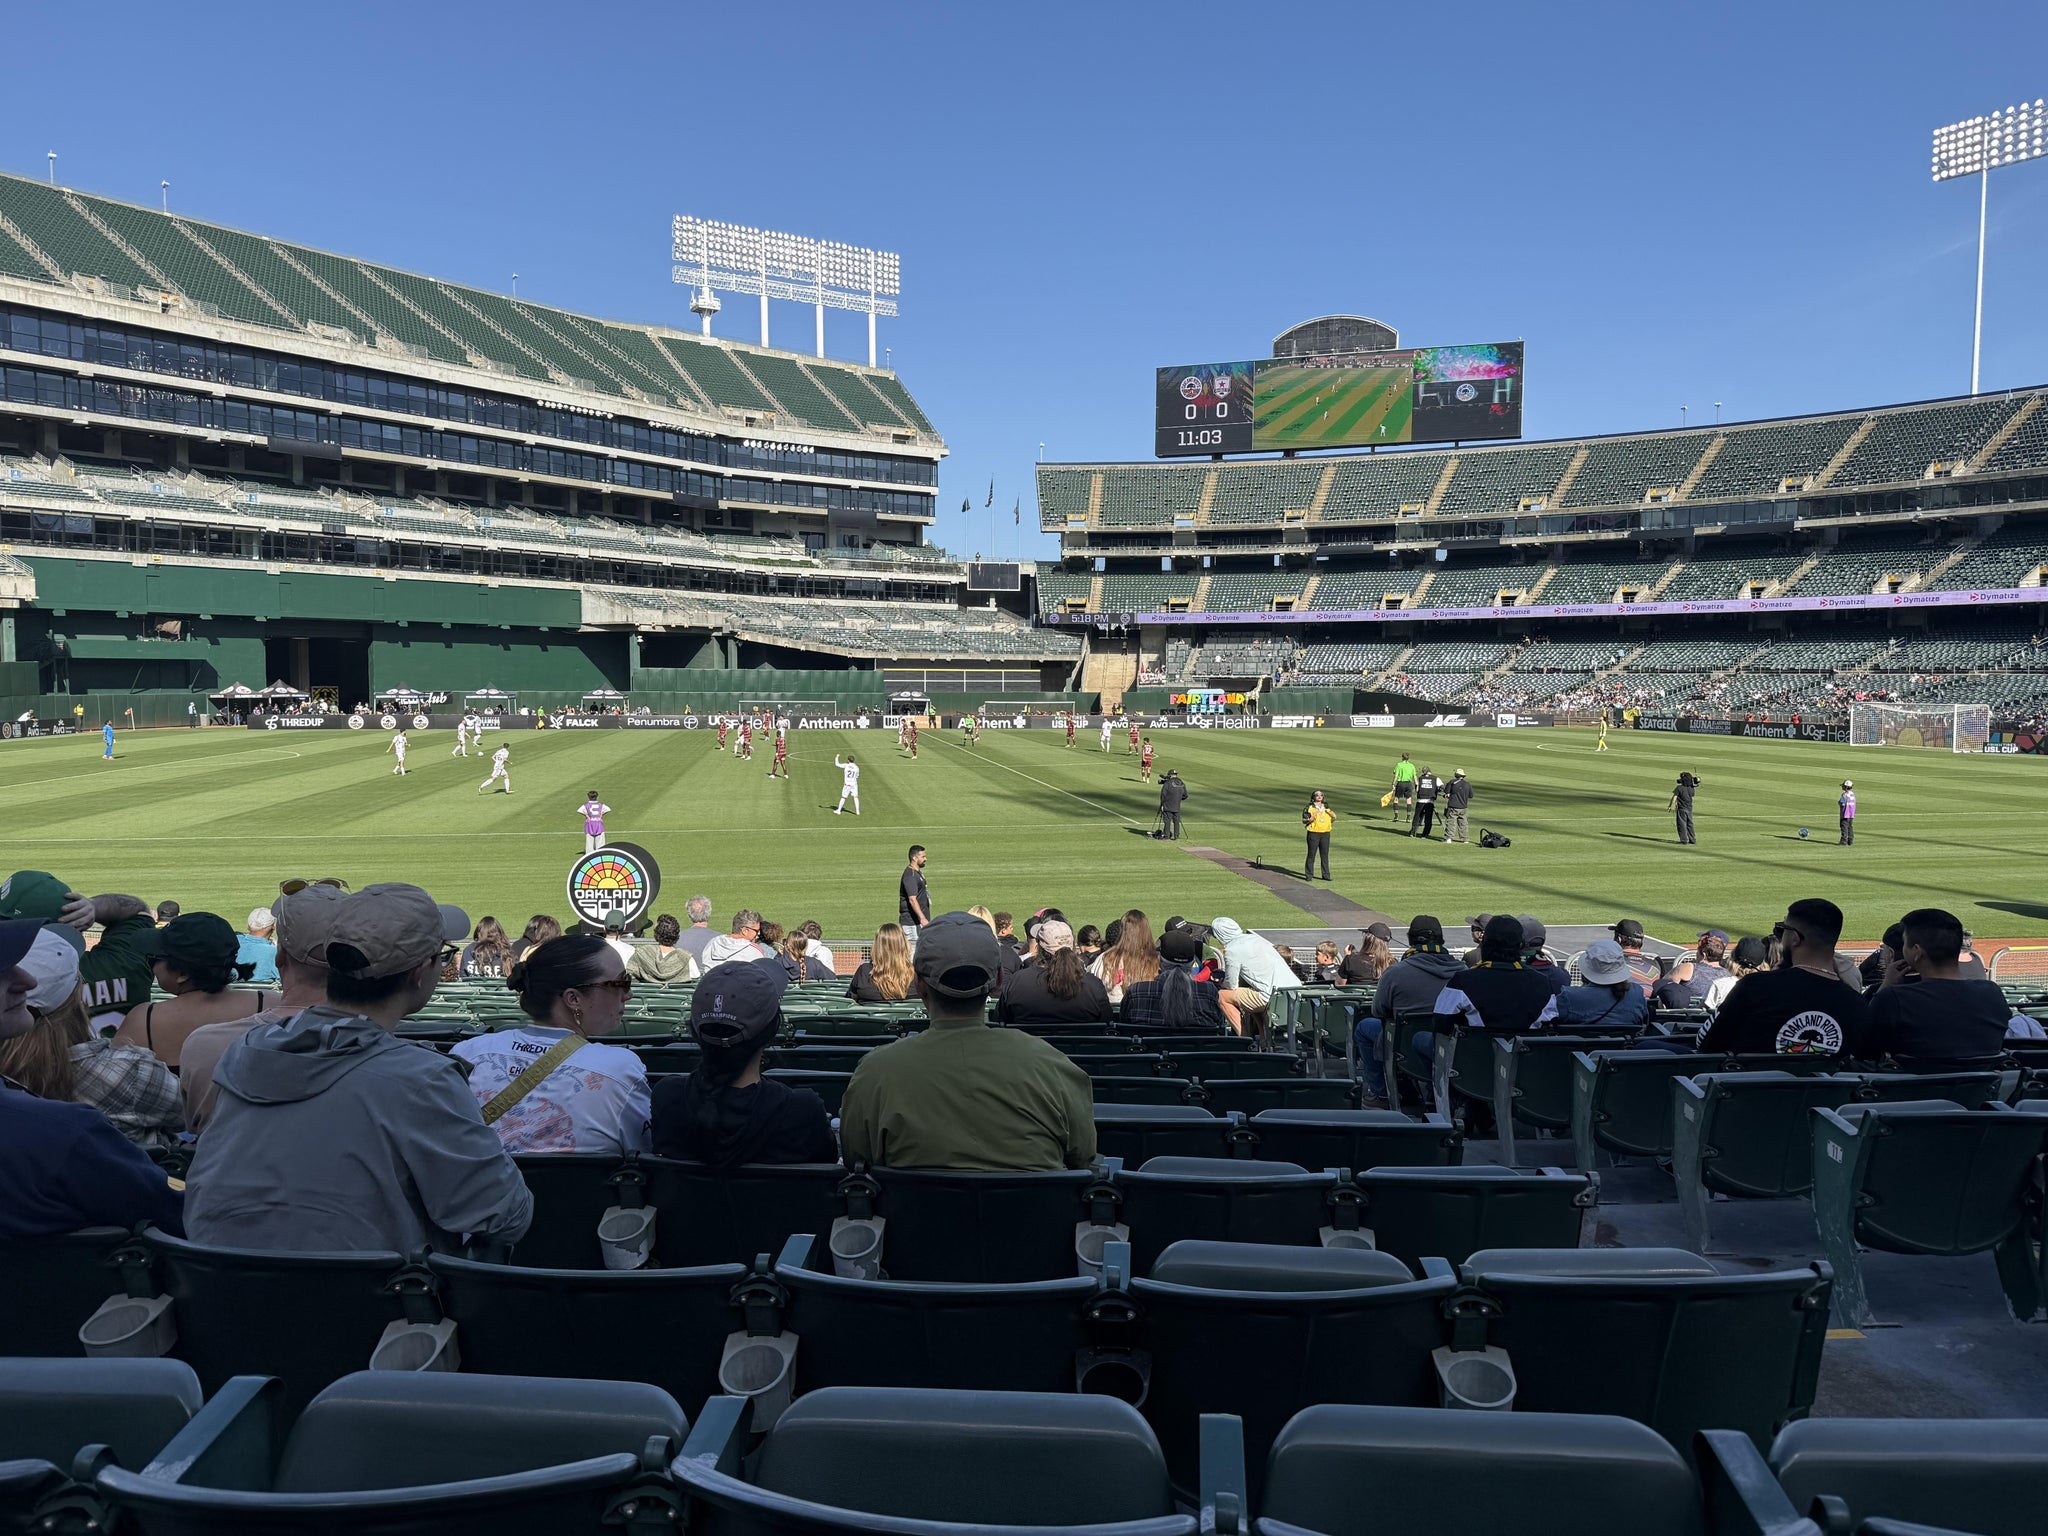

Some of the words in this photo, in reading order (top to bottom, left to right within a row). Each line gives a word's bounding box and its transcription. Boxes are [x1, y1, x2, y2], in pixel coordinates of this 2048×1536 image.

[1185, 404, 1197, 420] 0
[1216, 402, 1228, 418] 0
[1178, 429, 1222, 446] 11:03
[1904, 596, 1940, 604] Dymatize
[1980, 592, 2020, 601] Dymatize
[1626, 605, 1658, 613] Dymatize
[1691, 603, 1725, 611] Dymatize
[1759, 601, 1793, 609] Dymatize
[1562, 607, 1594, 615] Dymatize
[1071, 614, 1091, 623] 5:18
[1093, 614, 1109, 623] PM
[1170, 693, 1245, 705] FAIRYLAND
[280, 718, 324, 727] THREDUP
[566, 719, 598, 727] FALCK
[627, 717, 680, 727] Penumbra
[800, 717, 854, 729] Anthem
[1150, 720, 1168, 728] Ava
[1187, 715, 1213, 729] UCSF
[1215, 715, 1259, 729] Health
[1639, 718, 1677, 731] SEATGEEK
[1743, 723, 1784, 738] Anthem
[1801, 724, 1826, 741] UCSF
[2001, 746, 2019, 754] CUP
[847, 770, 855, 778] 21
[574, 889, 642, 899] OAKLAND
[1782, 1014, 1822, 1039] OAKLAND
[1820, 1017, 1839, 1048] ROOTS
[511, 1040, 551, 1054] THREDU
